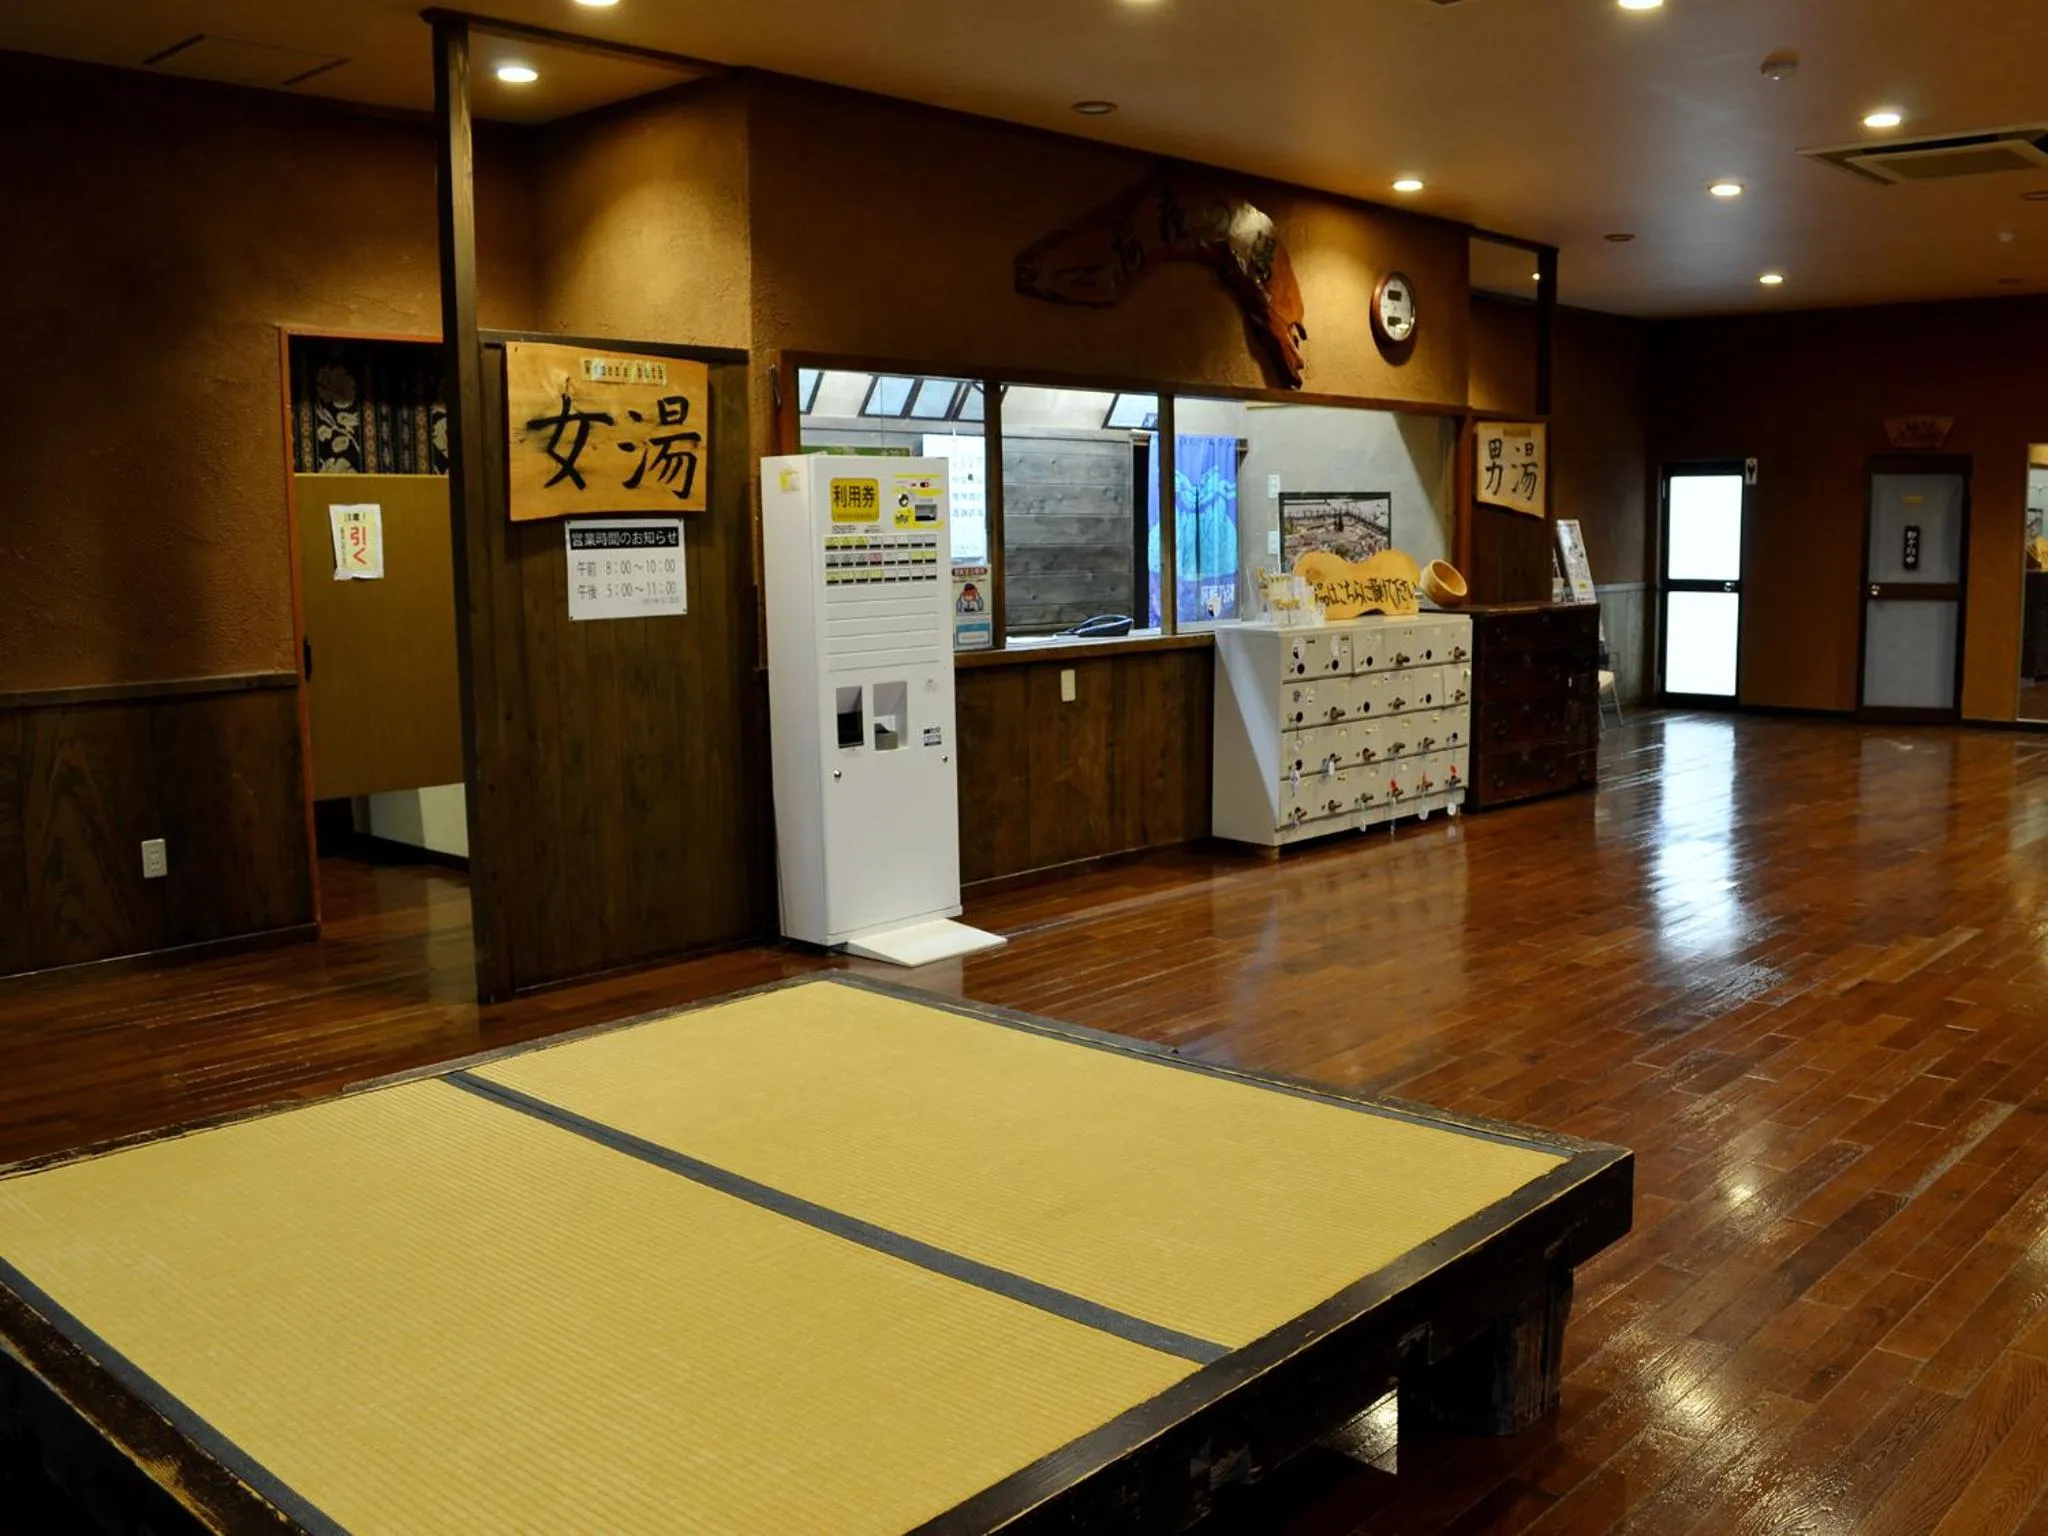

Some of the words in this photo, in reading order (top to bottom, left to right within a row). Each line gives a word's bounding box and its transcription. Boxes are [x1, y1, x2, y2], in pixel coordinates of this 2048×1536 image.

[527, 394, 702, 499] 女湯
[1485, 438, 1540, 501] 男湯
[833, 484, 875, 508] 利用券
[349, 526, 368, 565] 引く
[571, 530, 679, 547] 営業時間のお知らせ
[577, 560, 597, 577] 午前
[578, 584, 598, 600] 午後
